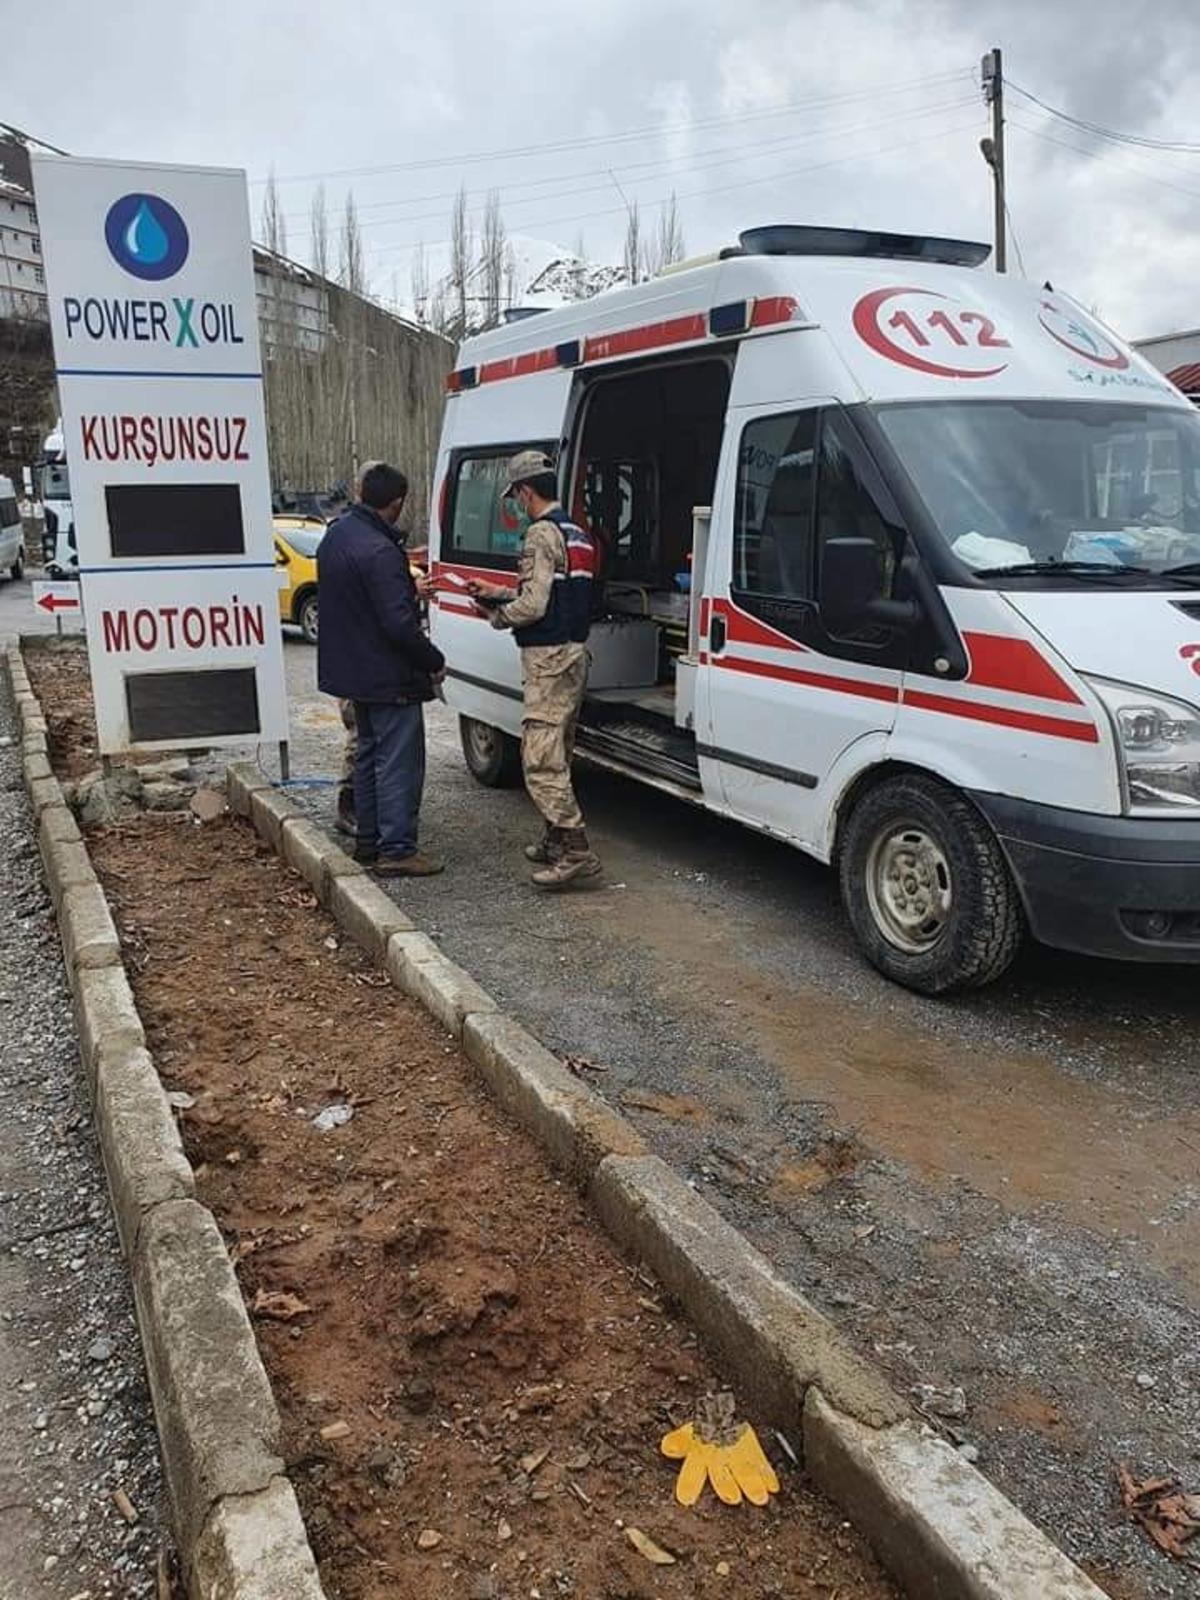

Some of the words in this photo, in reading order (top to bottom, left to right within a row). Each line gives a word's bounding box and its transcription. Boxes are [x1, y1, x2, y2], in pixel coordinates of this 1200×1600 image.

[888, 311, 1012, 347] 112
[81, 415, 249, 467] KURŞUNSUZ
[102, 595, 265, 652] MOTORİN
